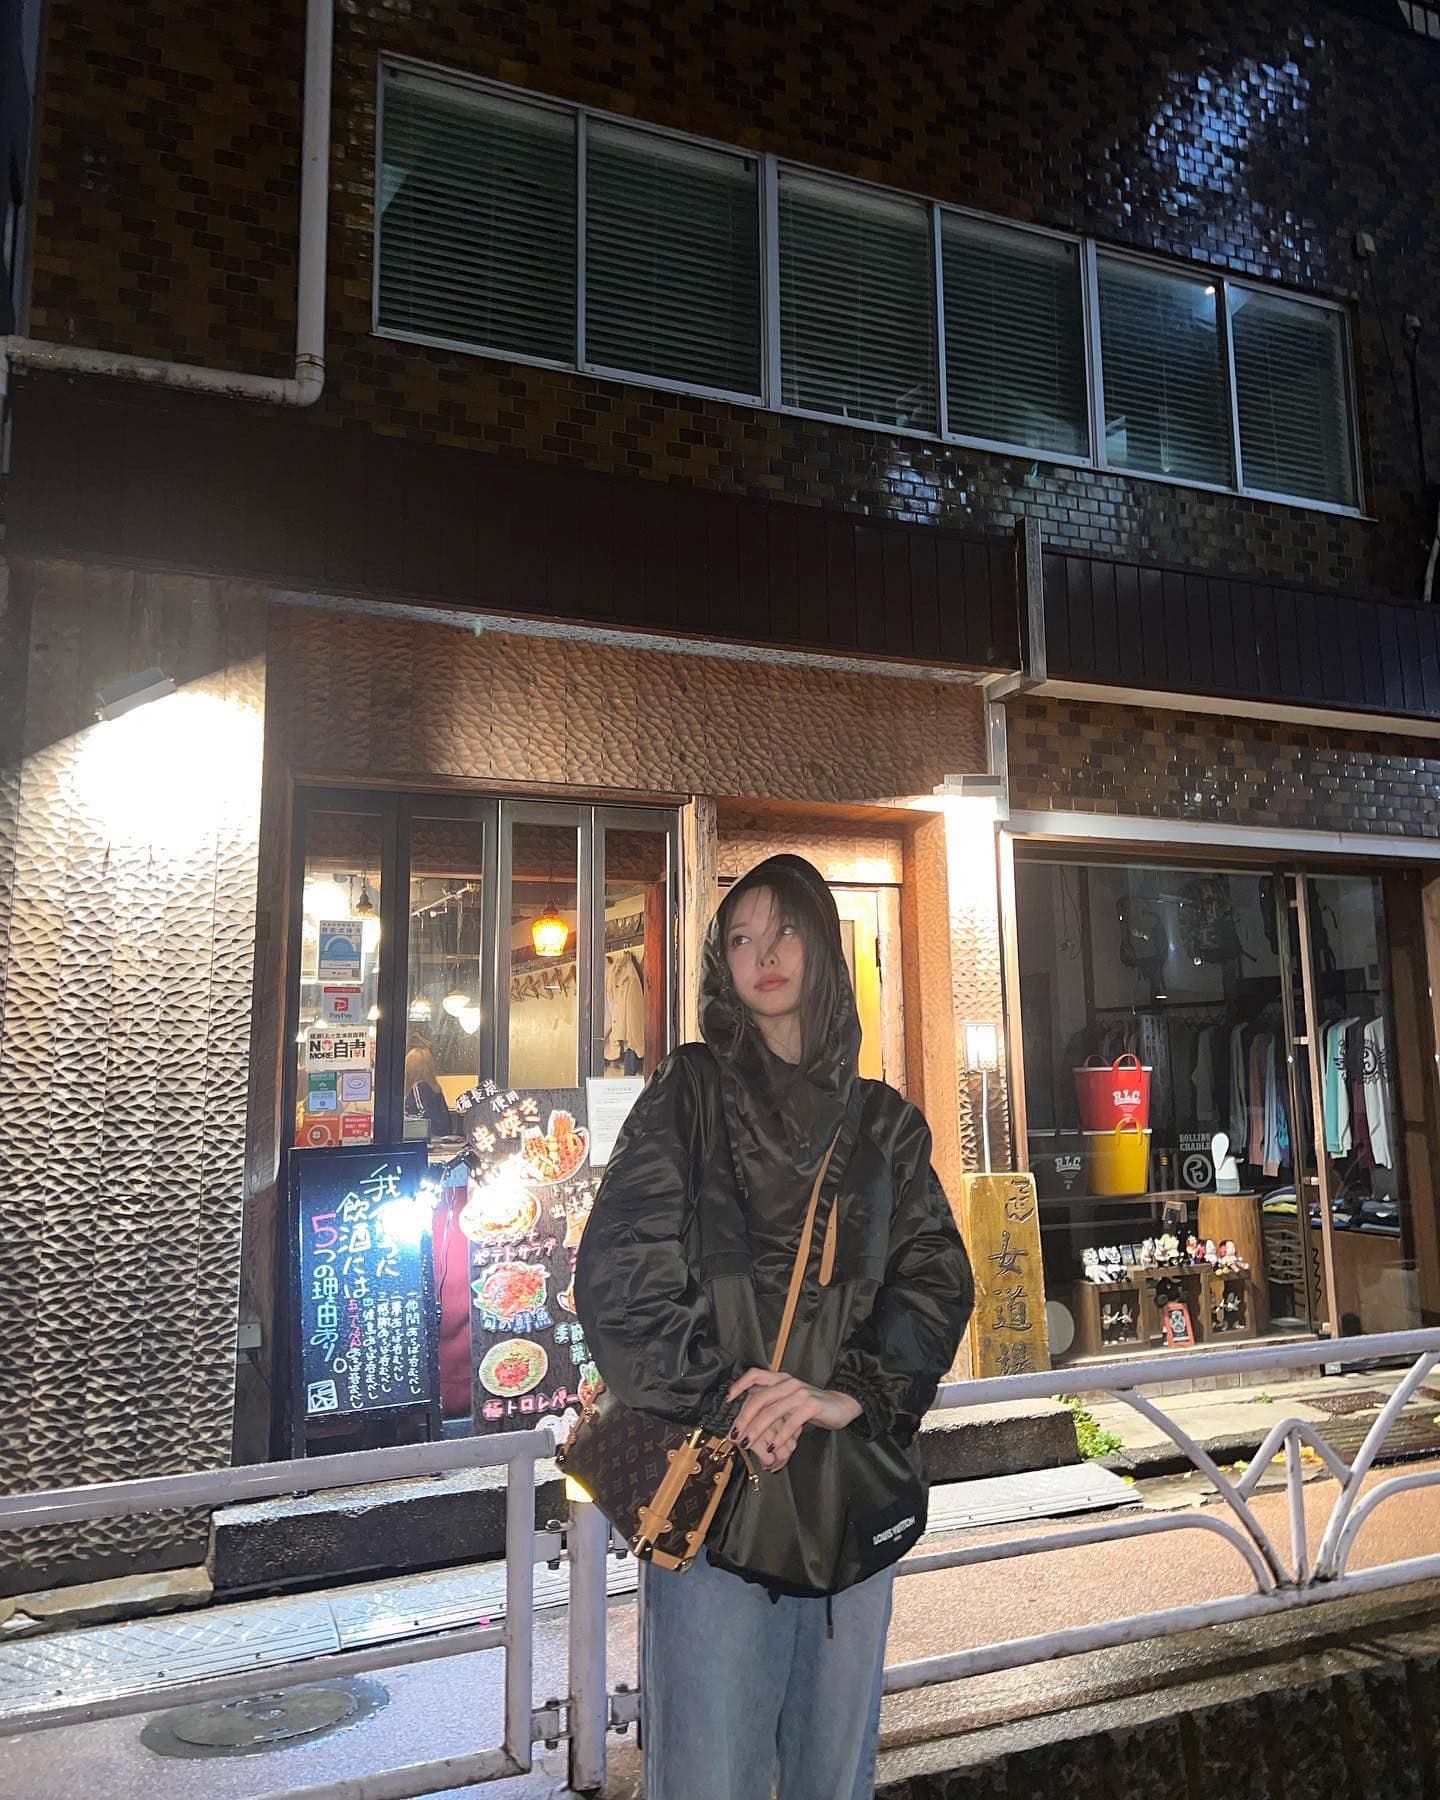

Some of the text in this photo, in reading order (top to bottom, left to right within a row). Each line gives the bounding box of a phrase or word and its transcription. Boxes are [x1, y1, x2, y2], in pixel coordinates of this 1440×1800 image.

[310, 1052, 333, 1060] MORE
[491, 1090, 520, 1113] 使用
[336, 1192, 371, 1299] 飲酒には
[474, 1237, 557, 1266] ポテトサラダ
